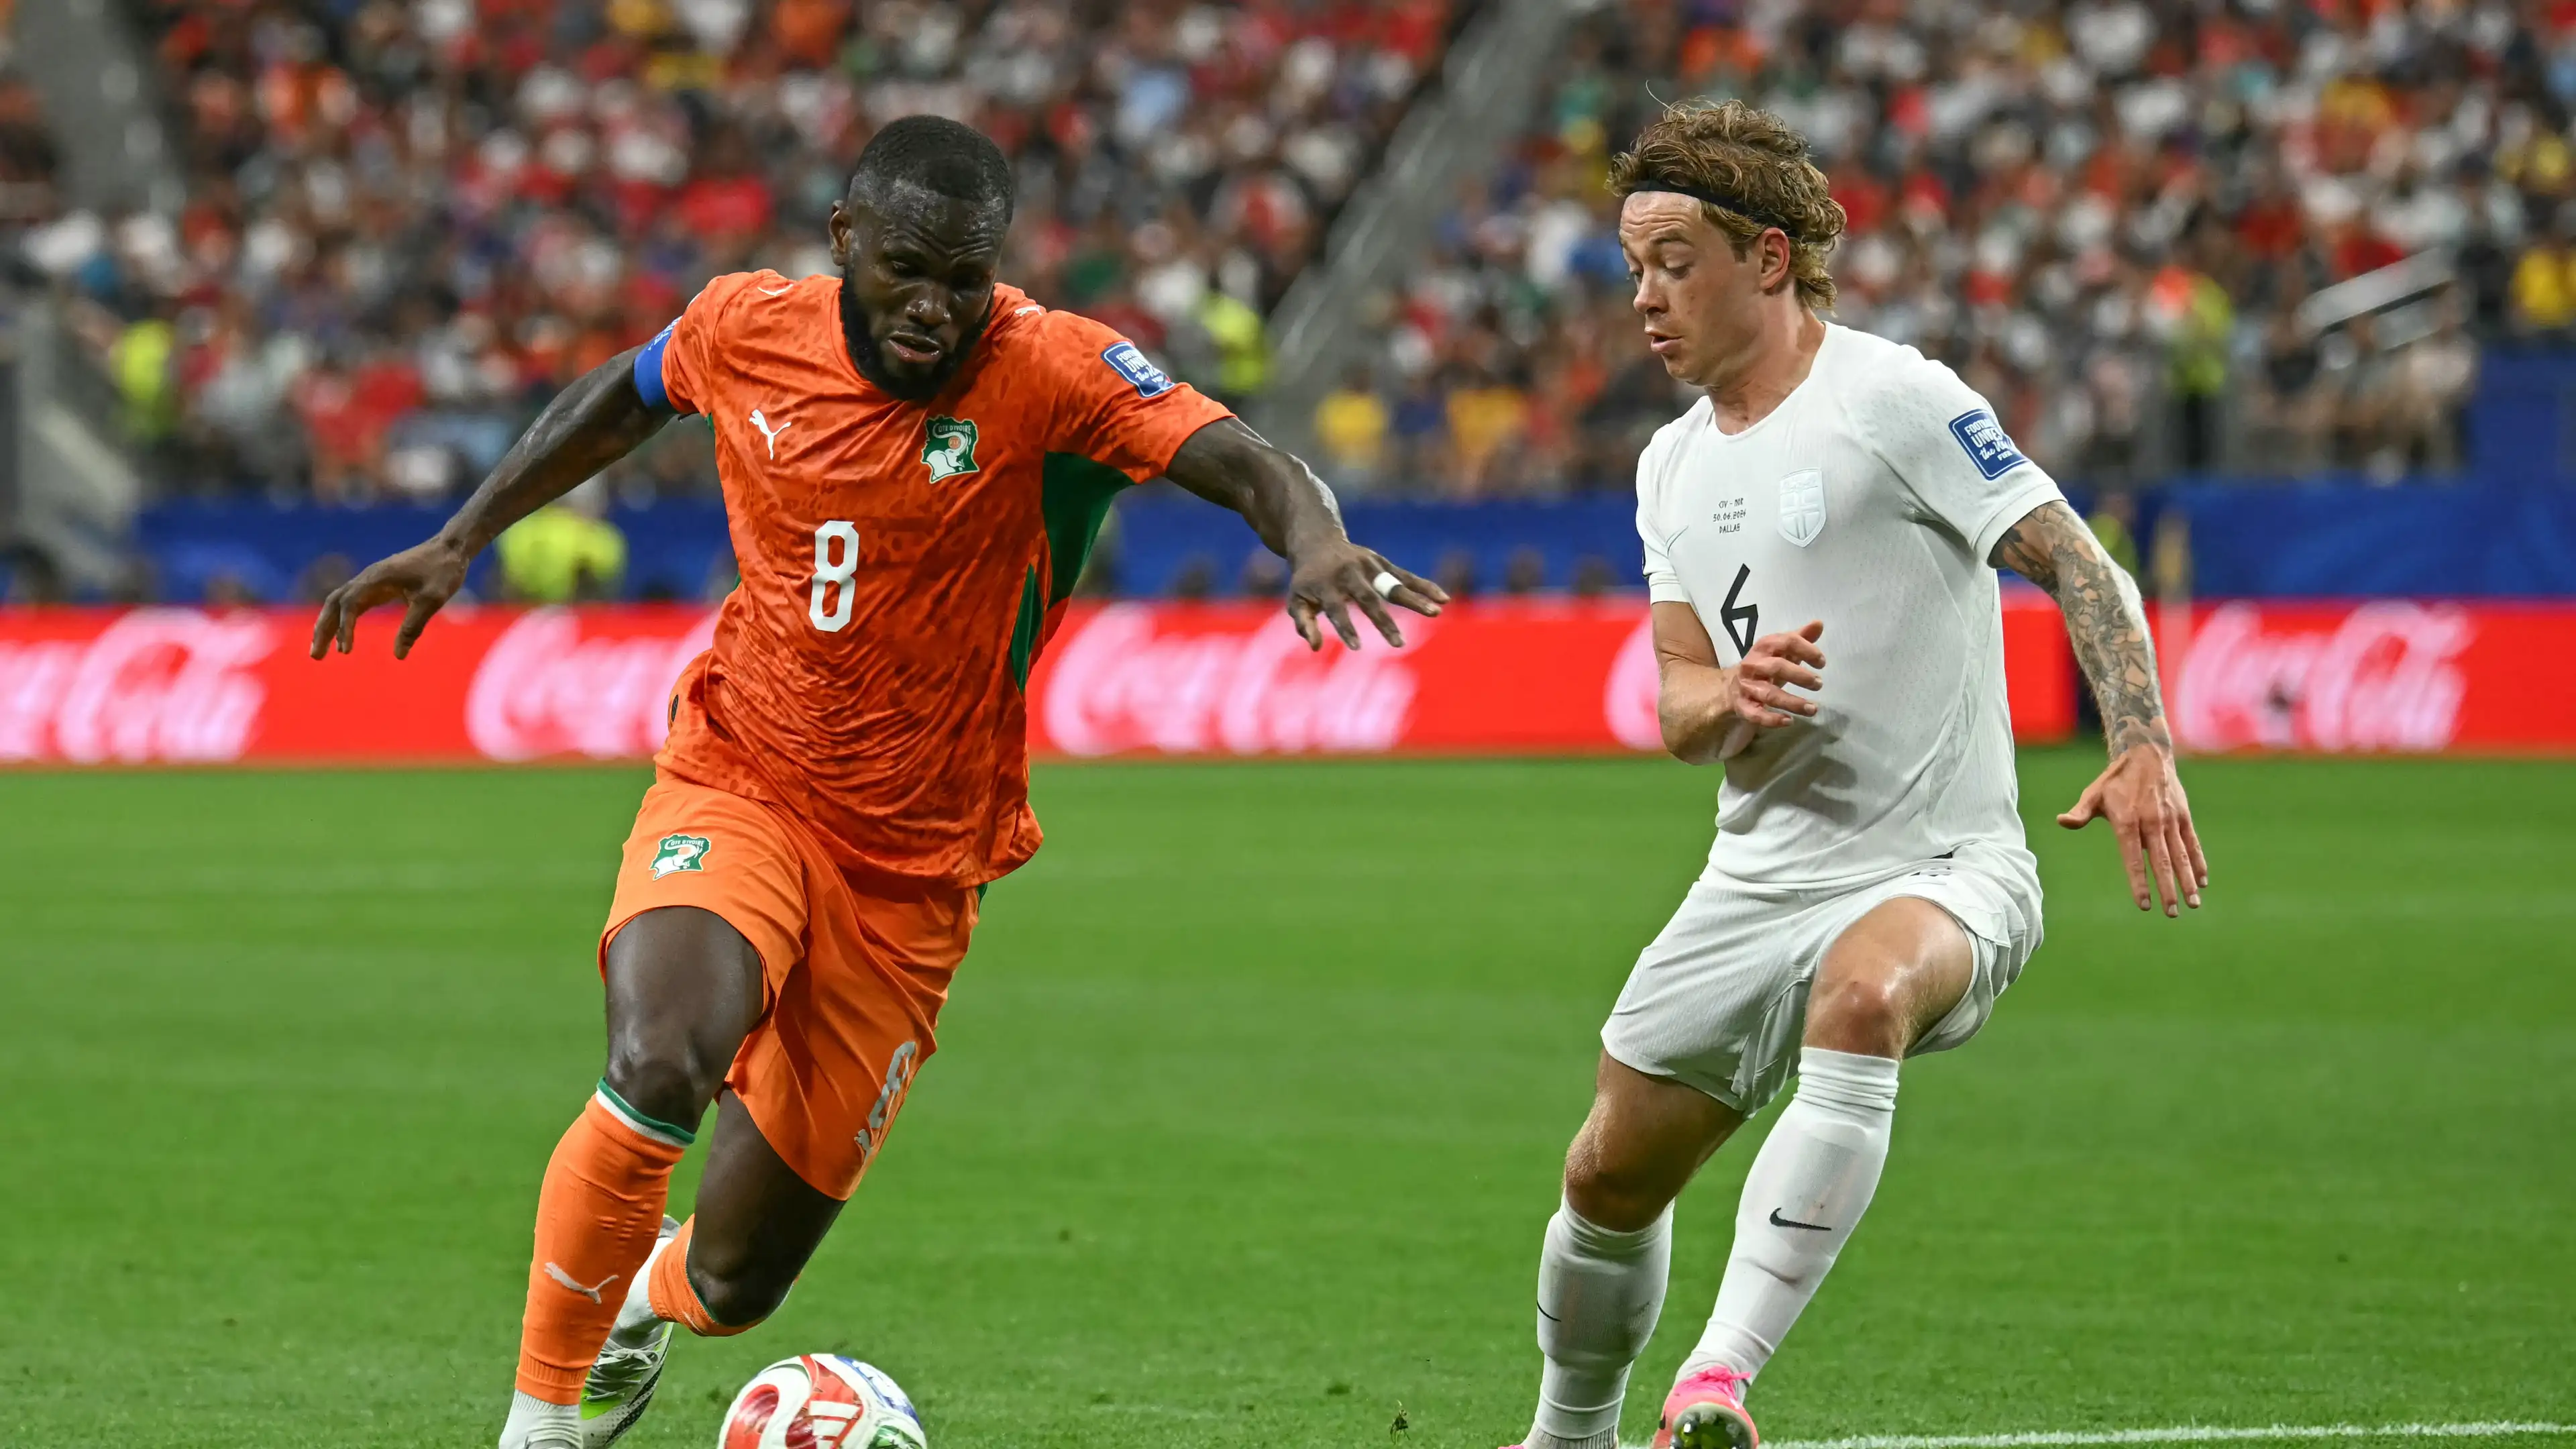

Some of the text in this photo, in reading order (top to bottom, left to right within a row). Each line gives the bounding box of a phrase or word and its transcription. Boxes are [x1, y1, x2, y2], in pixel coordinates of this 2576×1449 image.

[1979, 447, 1996, 460] the
[1719, 523, 1740, 534] DALLAS
[808, 520, 859, 632] 8
[1721, 563, 1759, 660] 6
